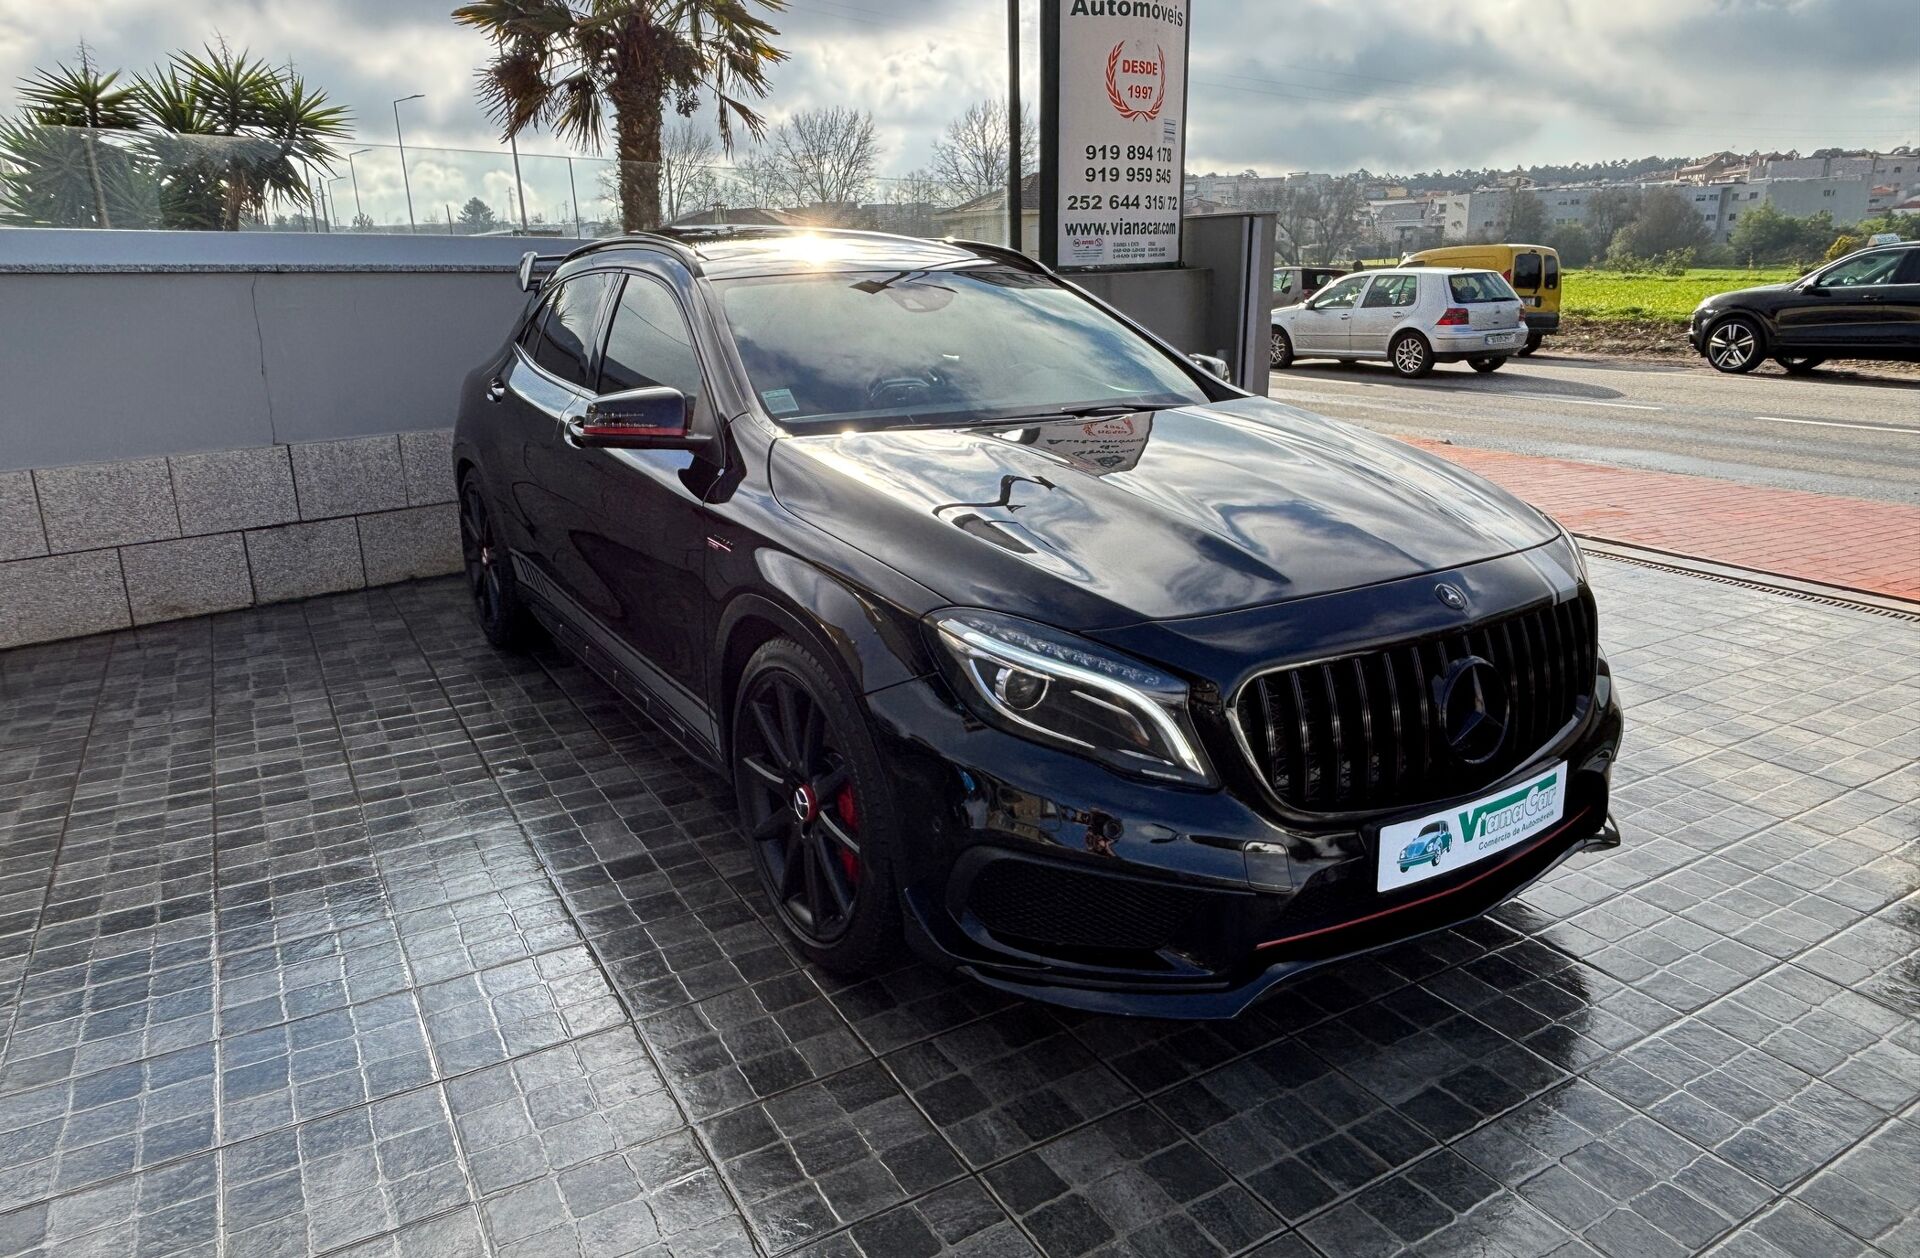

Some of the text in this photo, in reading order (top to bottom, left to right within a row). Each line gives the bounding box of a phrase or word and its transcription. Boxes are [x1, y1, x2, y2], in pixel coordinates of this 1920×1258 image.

[1122, 60, 1158, 75] DESDE
[1127, 85, 1153, 99] 1997
[1085, 145, 1172, 162] 919 894 178
[1085, 167, 1171, 183] 919 959 545
[1067, 195, 1103, 210] 252
[1109, 195, 1140, 210] 644
[1065, 218, 1176, 236] www.vianacar.com
[1458, 773, 1557, 843] VianaCar
[1512, 827, 1520, 836] de
